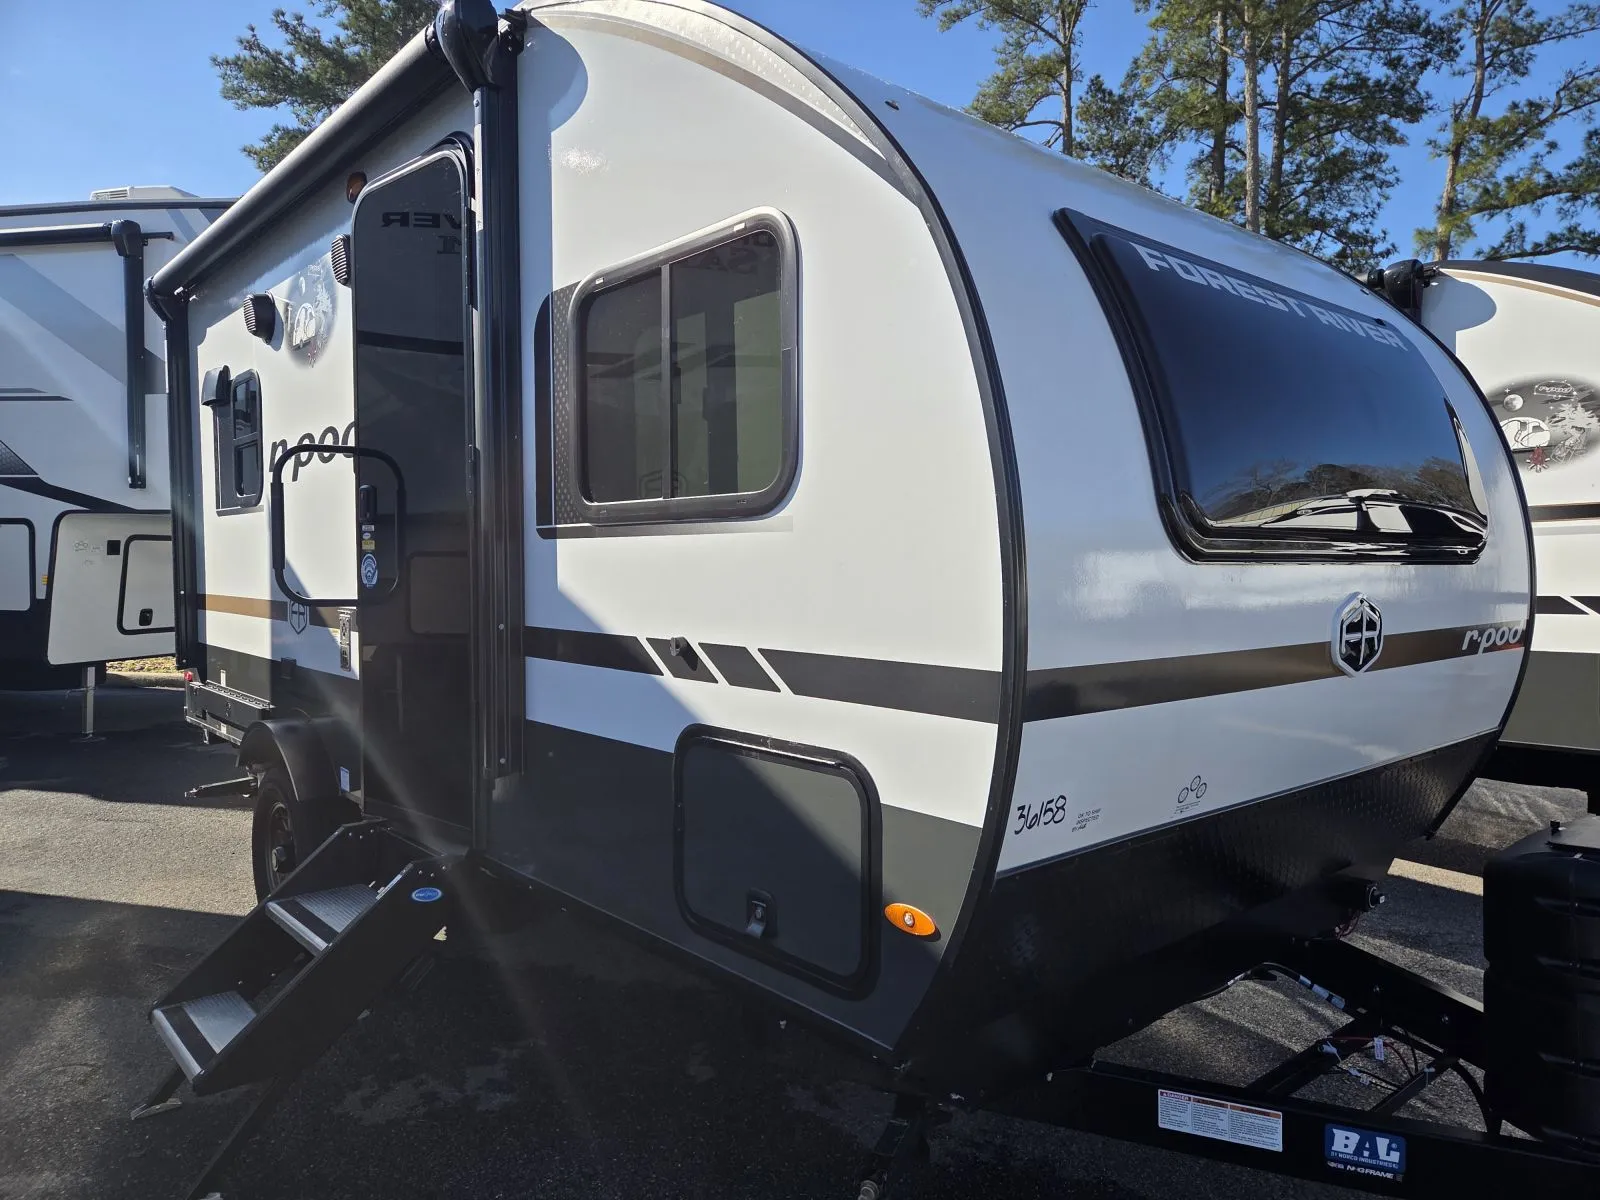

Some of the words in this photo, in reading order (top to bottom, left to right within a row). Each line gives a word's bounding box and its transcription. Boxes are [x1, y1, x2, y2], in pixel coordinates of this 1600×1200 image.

[1129, 242, 1306, 318] FOREST
[1304, 303, 1408, 351] RIVER
[1014, 795, 1067, 835] 36158
[1331, 1128, 1400, 1163] BAL
[1358, 1156, 1392, 1168] INDUSTRIES
